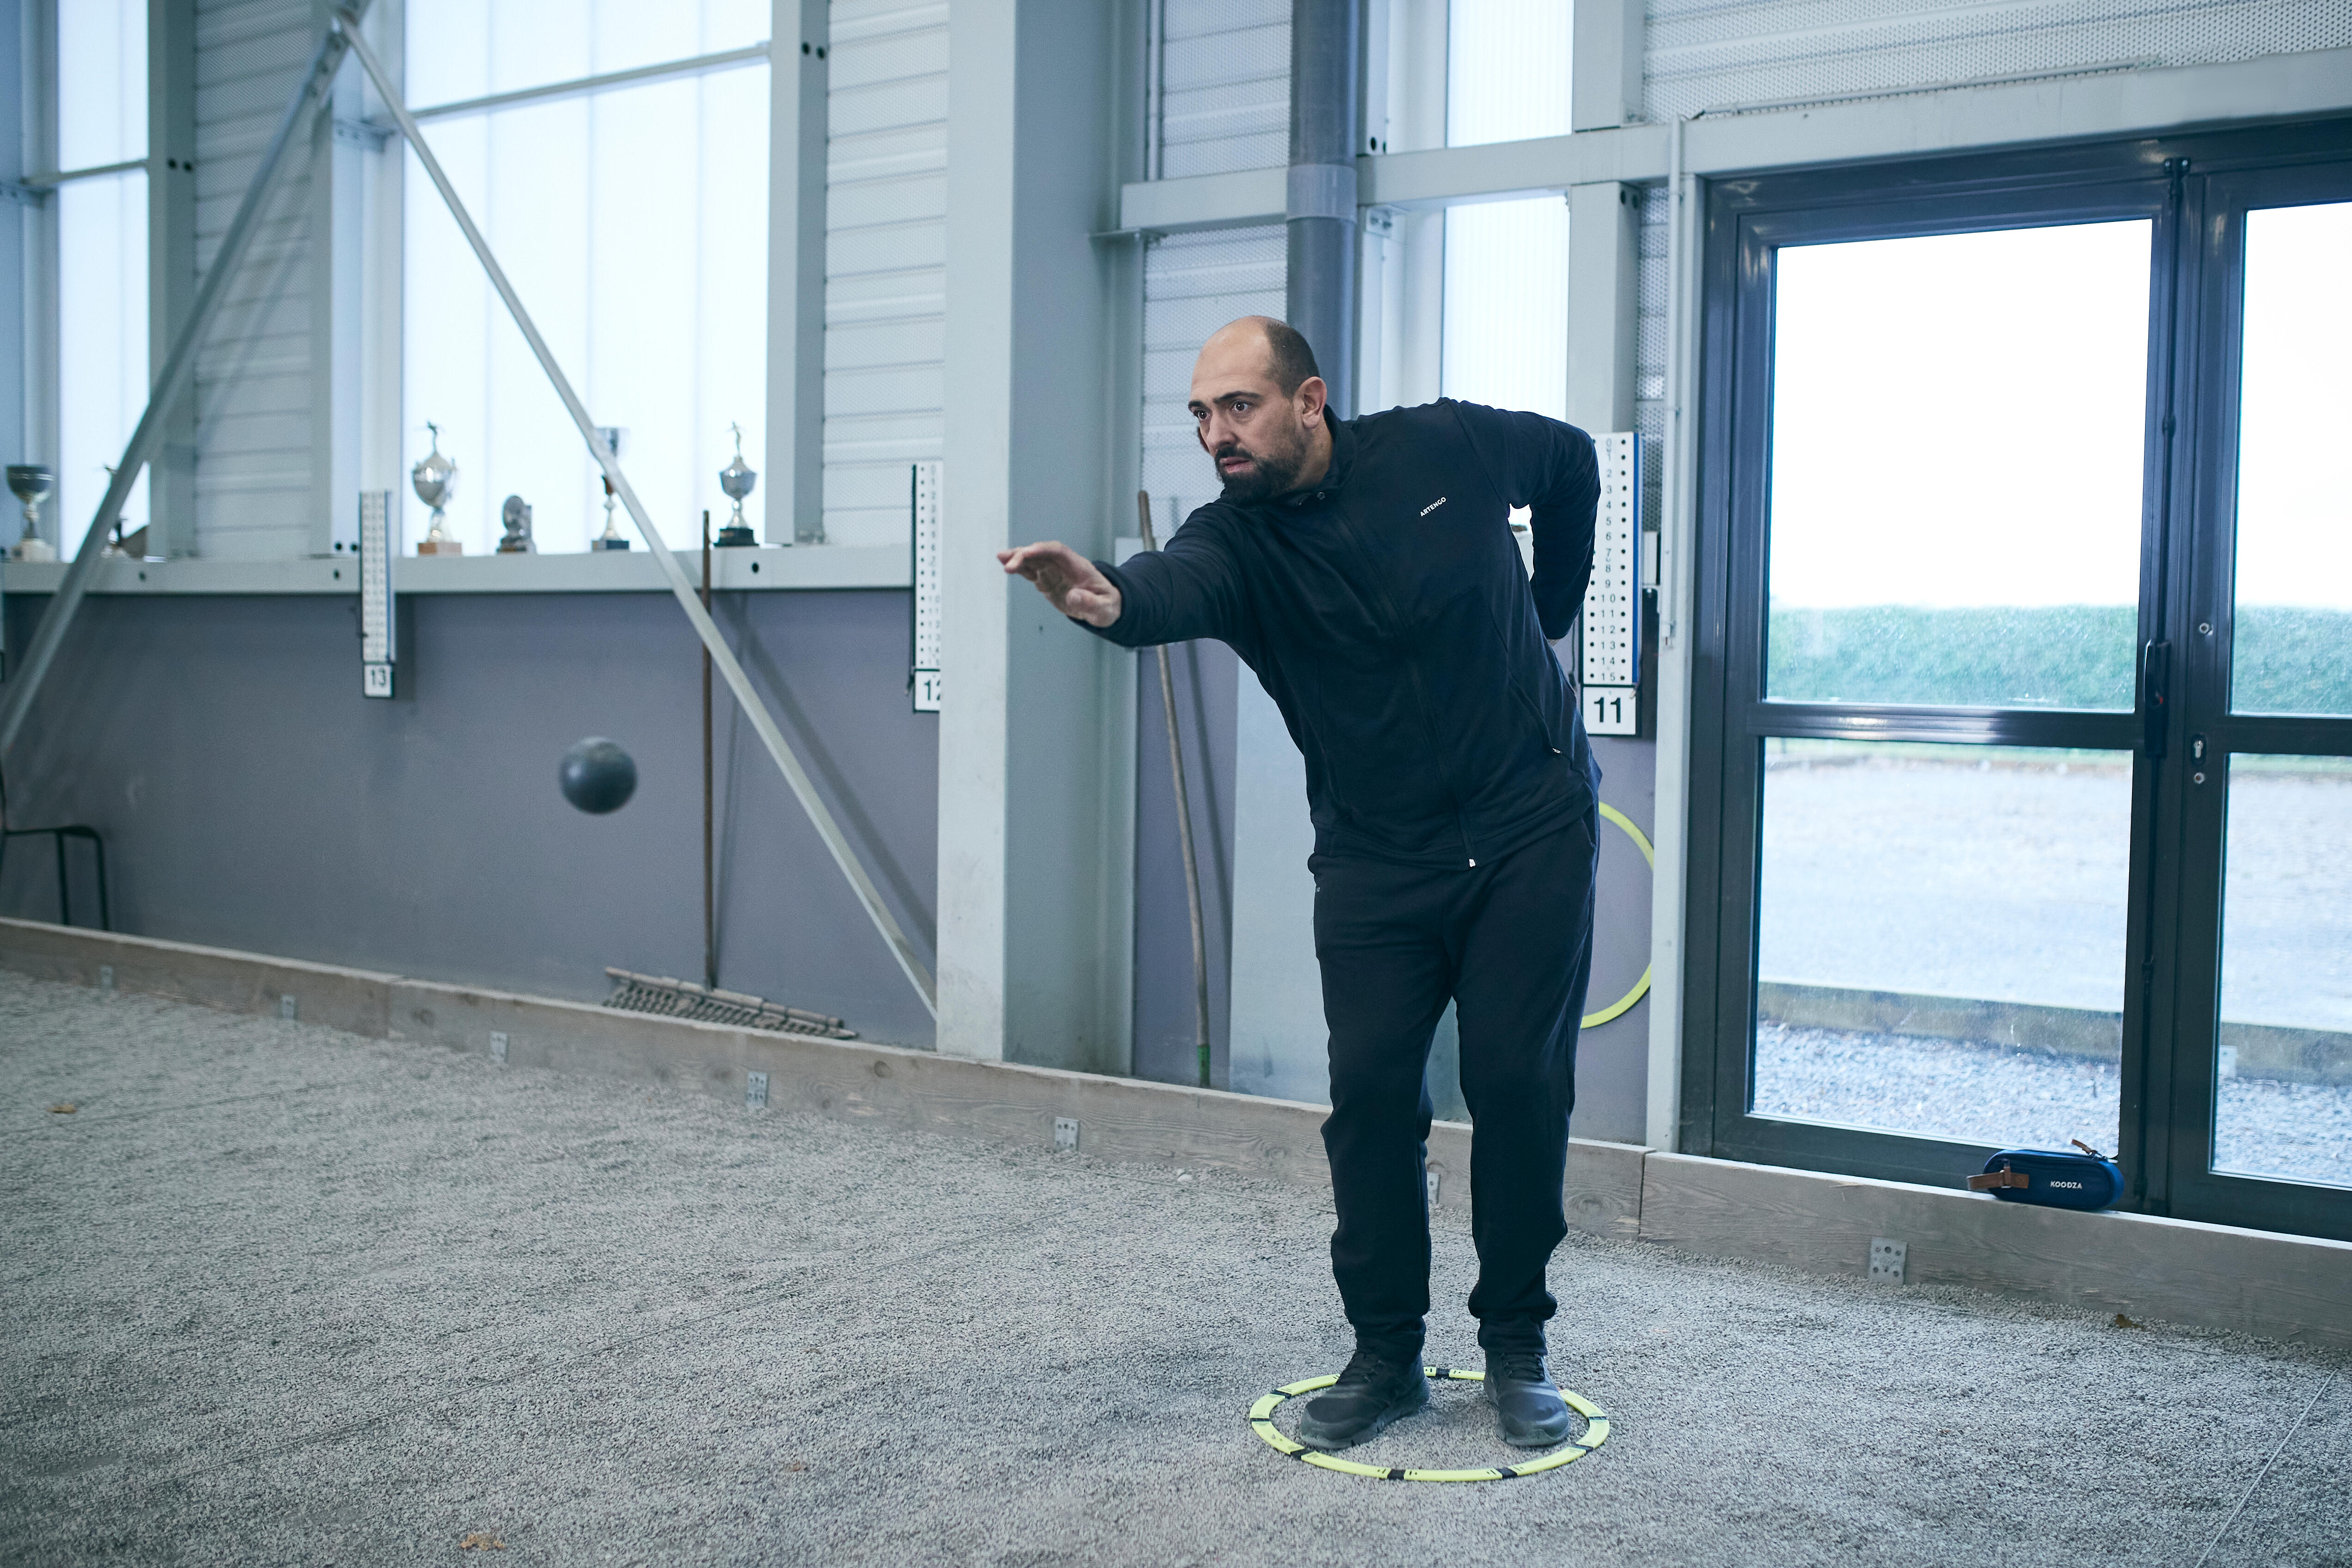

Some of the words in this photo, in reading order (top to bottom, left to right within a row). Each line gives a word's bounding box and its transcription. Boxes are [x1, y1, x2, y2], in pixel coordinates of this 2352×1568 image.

[1606, 437, 1612, 447] 0
[1607, 470, 1612, 478] 2
[1607, 485, 1612, 494] 3
[1420, 497, 1446, 517] ARTENGO
[1607, 500, 1611, 509] 4
[1606, 517, 1611, 526] 5
[1606, 532, 1611, 541] 6
[1606, 548, 1612, 557] 7
[1606, 564, 1611, 573] 8
[1605, 579, 1610, 588] 9
[371, 669, 386, 687] 13
[1594, 697, 1621, 723] 11
[2050, 1181, 2083, 1189] KOODZA
